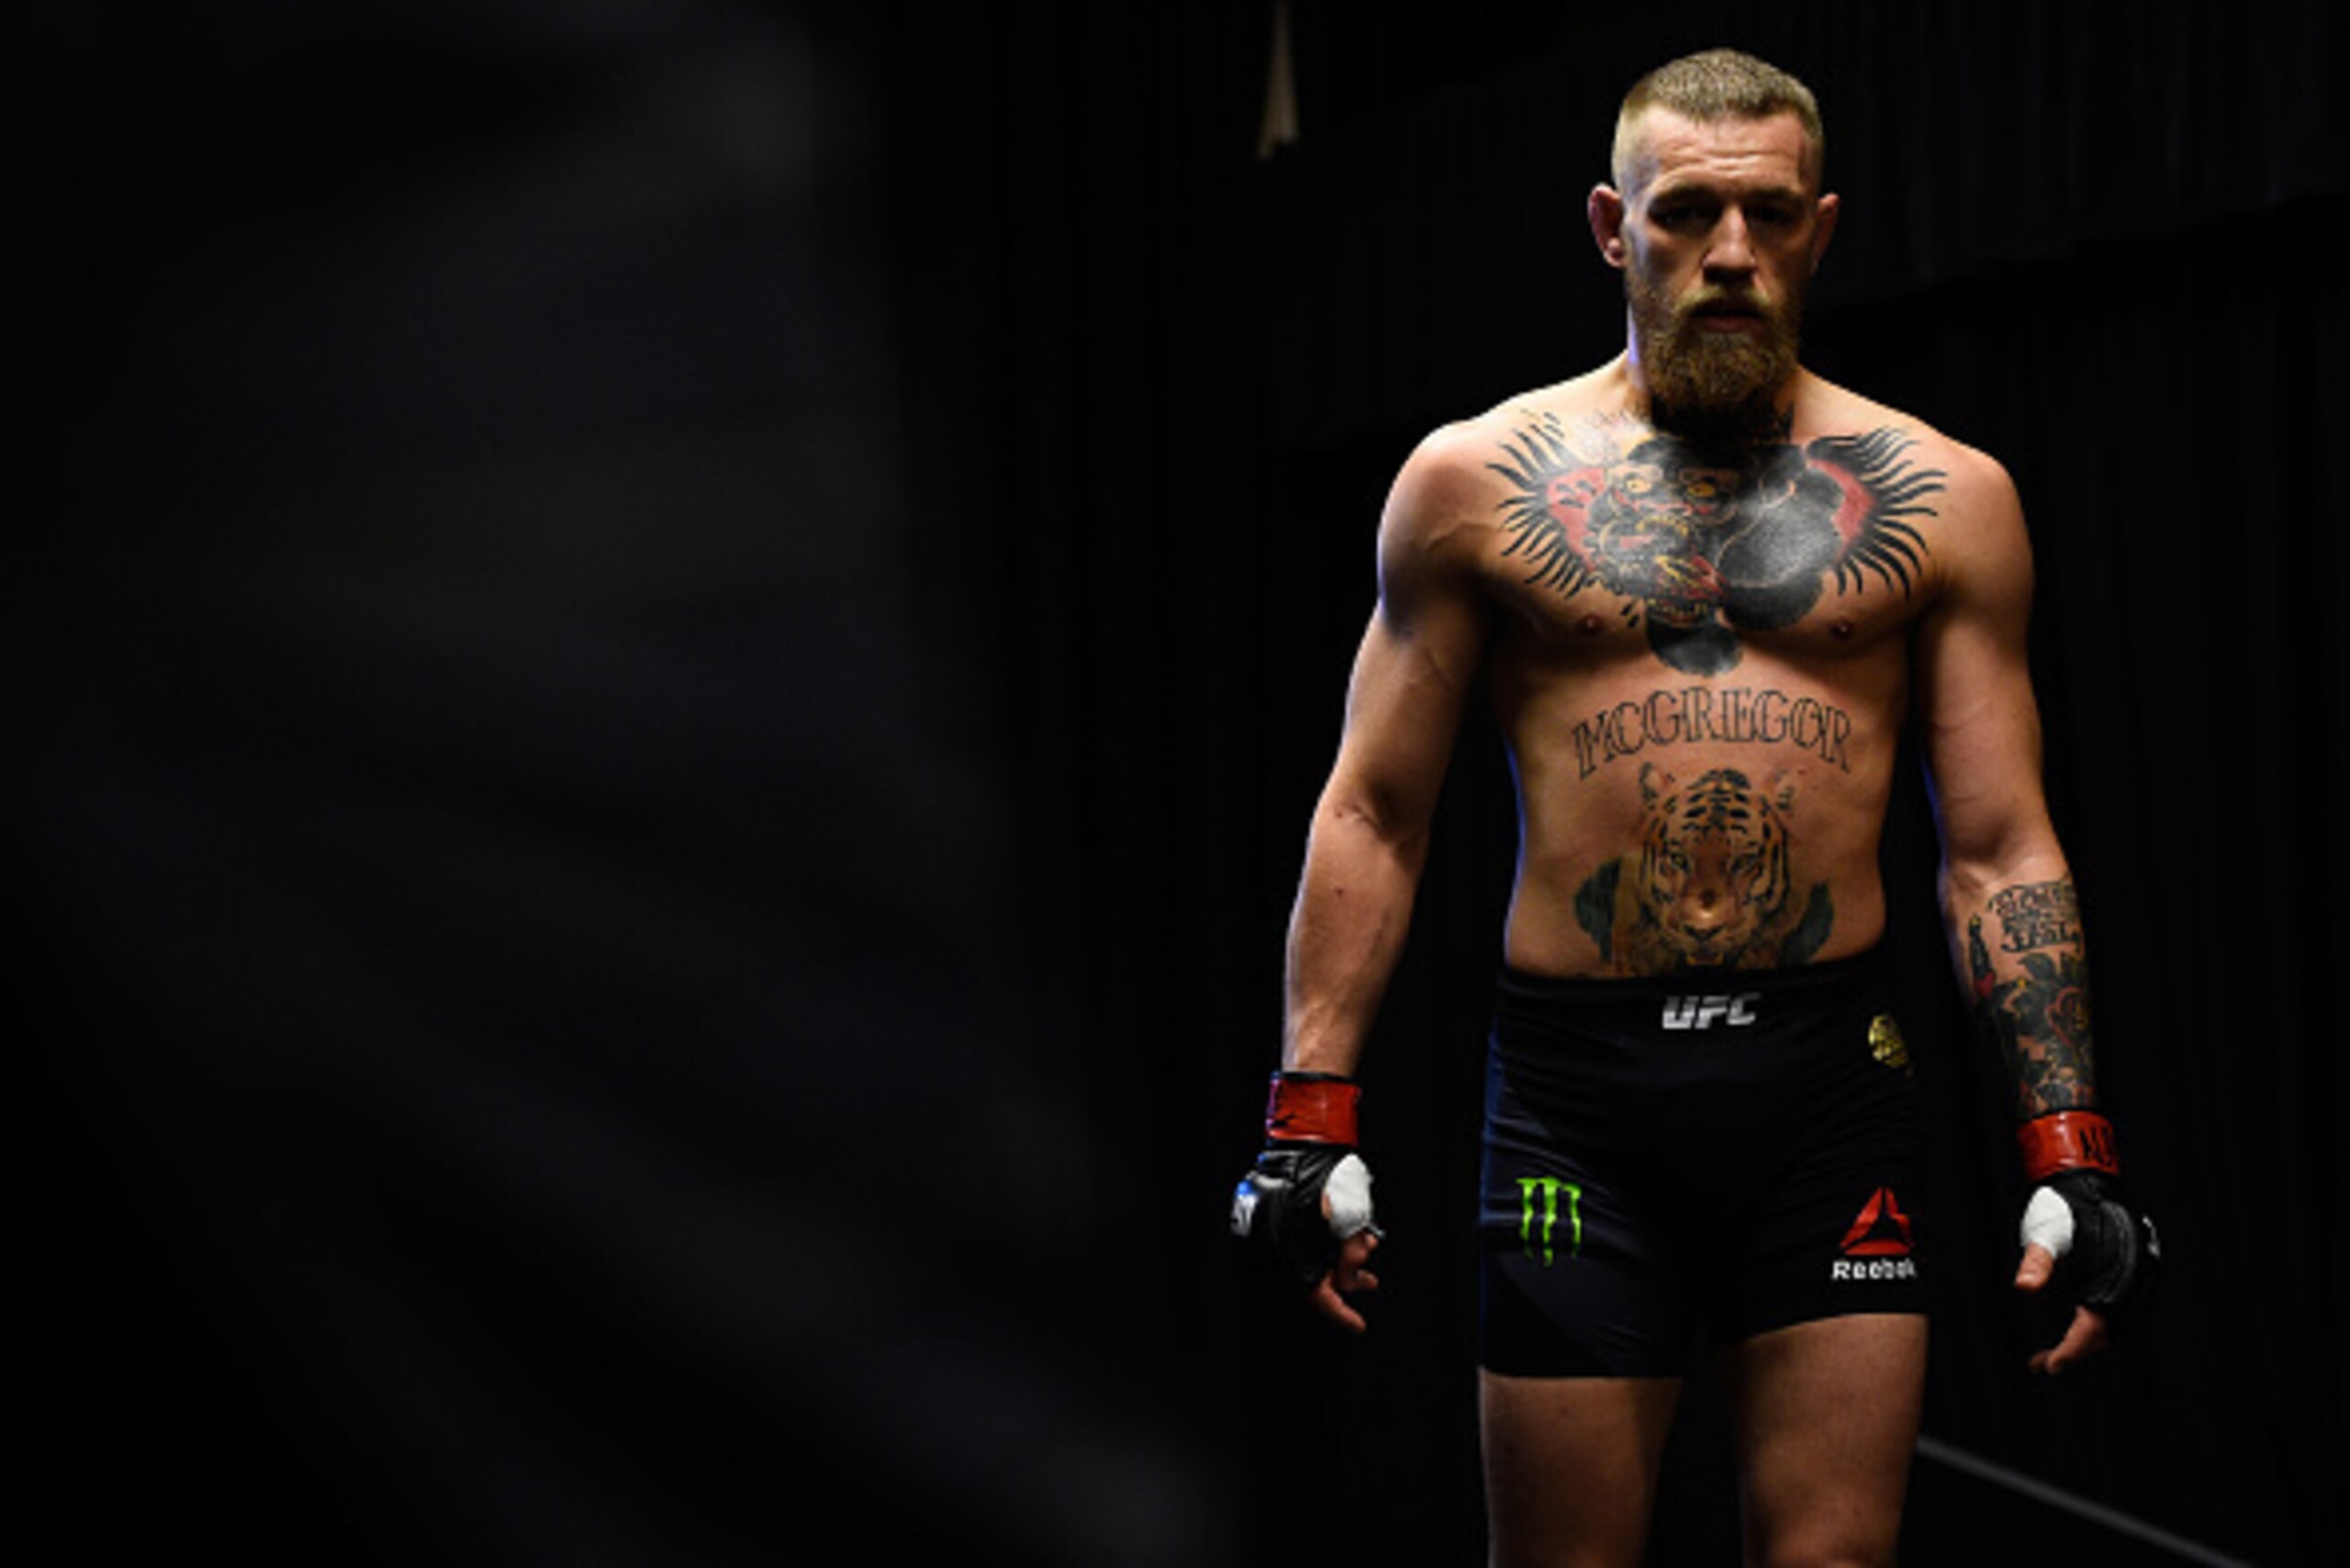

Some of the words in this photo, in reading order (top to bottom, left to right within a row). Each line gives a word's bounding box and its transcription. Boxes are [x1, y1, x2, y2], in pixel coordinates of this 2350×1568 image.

[1572, 687, 1852, 780] MCGREGOR
[1661, 991, 1762, 1030] UFC
[1830, 1257, 1919, 1281] Reebok
